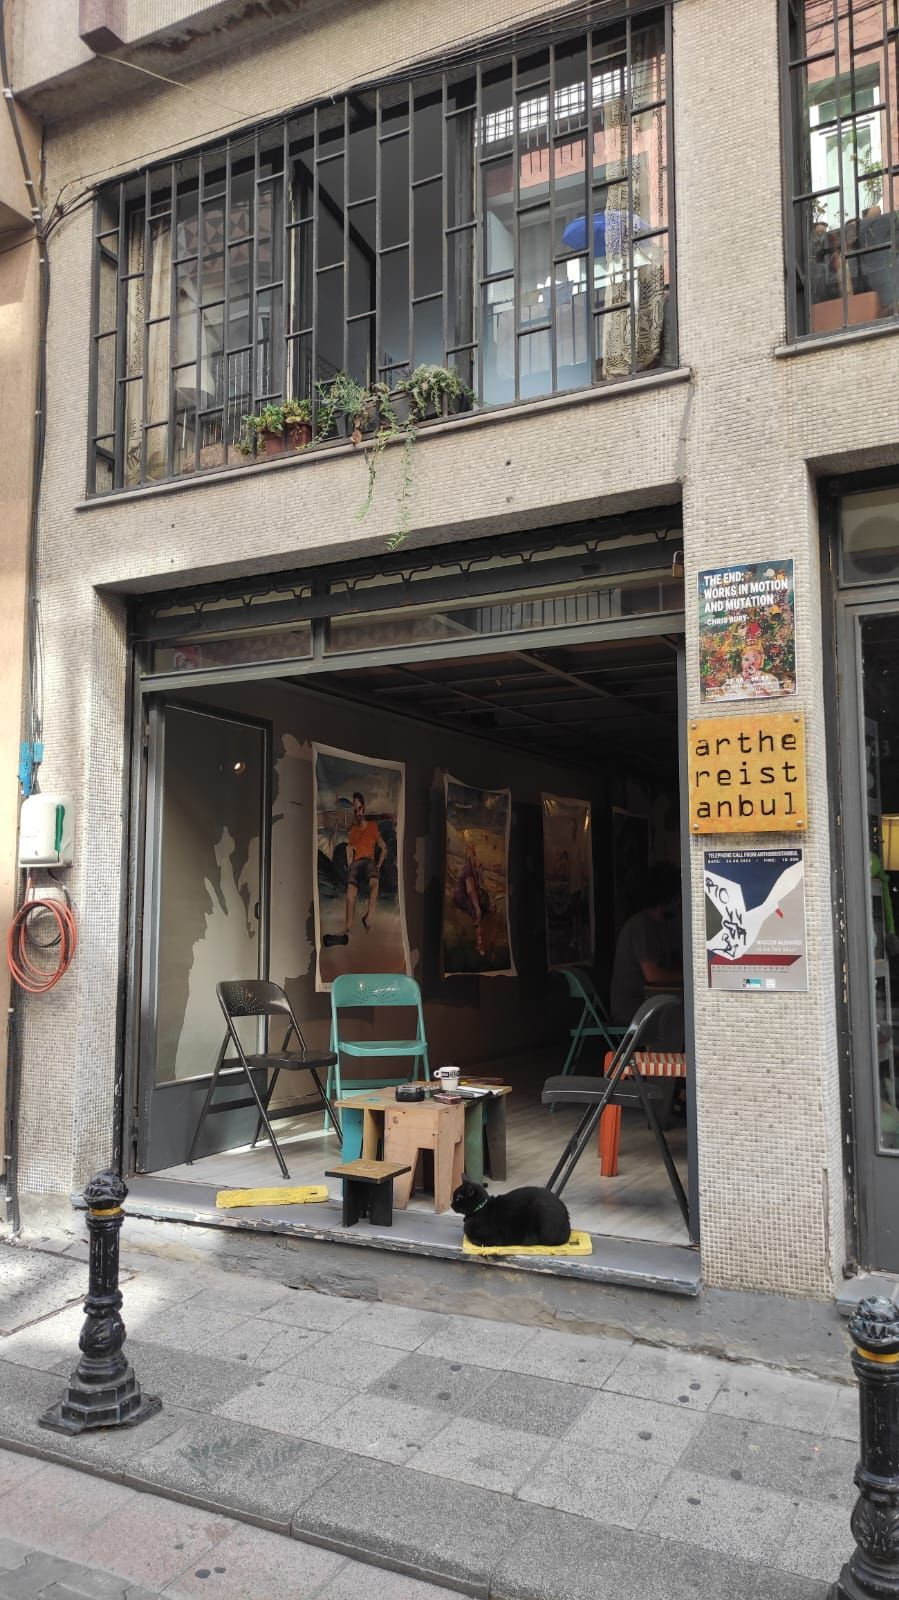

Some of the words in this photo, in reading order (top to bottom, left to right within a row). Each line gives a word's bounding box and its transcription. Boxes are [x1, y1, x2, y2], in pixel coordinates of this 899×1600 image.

[704, 574, 721, 586] THE
[723, 571, 744, 584] END:
[704, 586, 737, 600] WORKS
[738, 584, 748, 595] IN
[750, 579, 788, 593] MOTION
[705, 600, 724, 613] AND
[726, 594, 774, 612] MUTATION
[695, 730, 797, 756] arthe
[696, 761, 798, 788] reist
[697, 792, 797, 818] anbul
